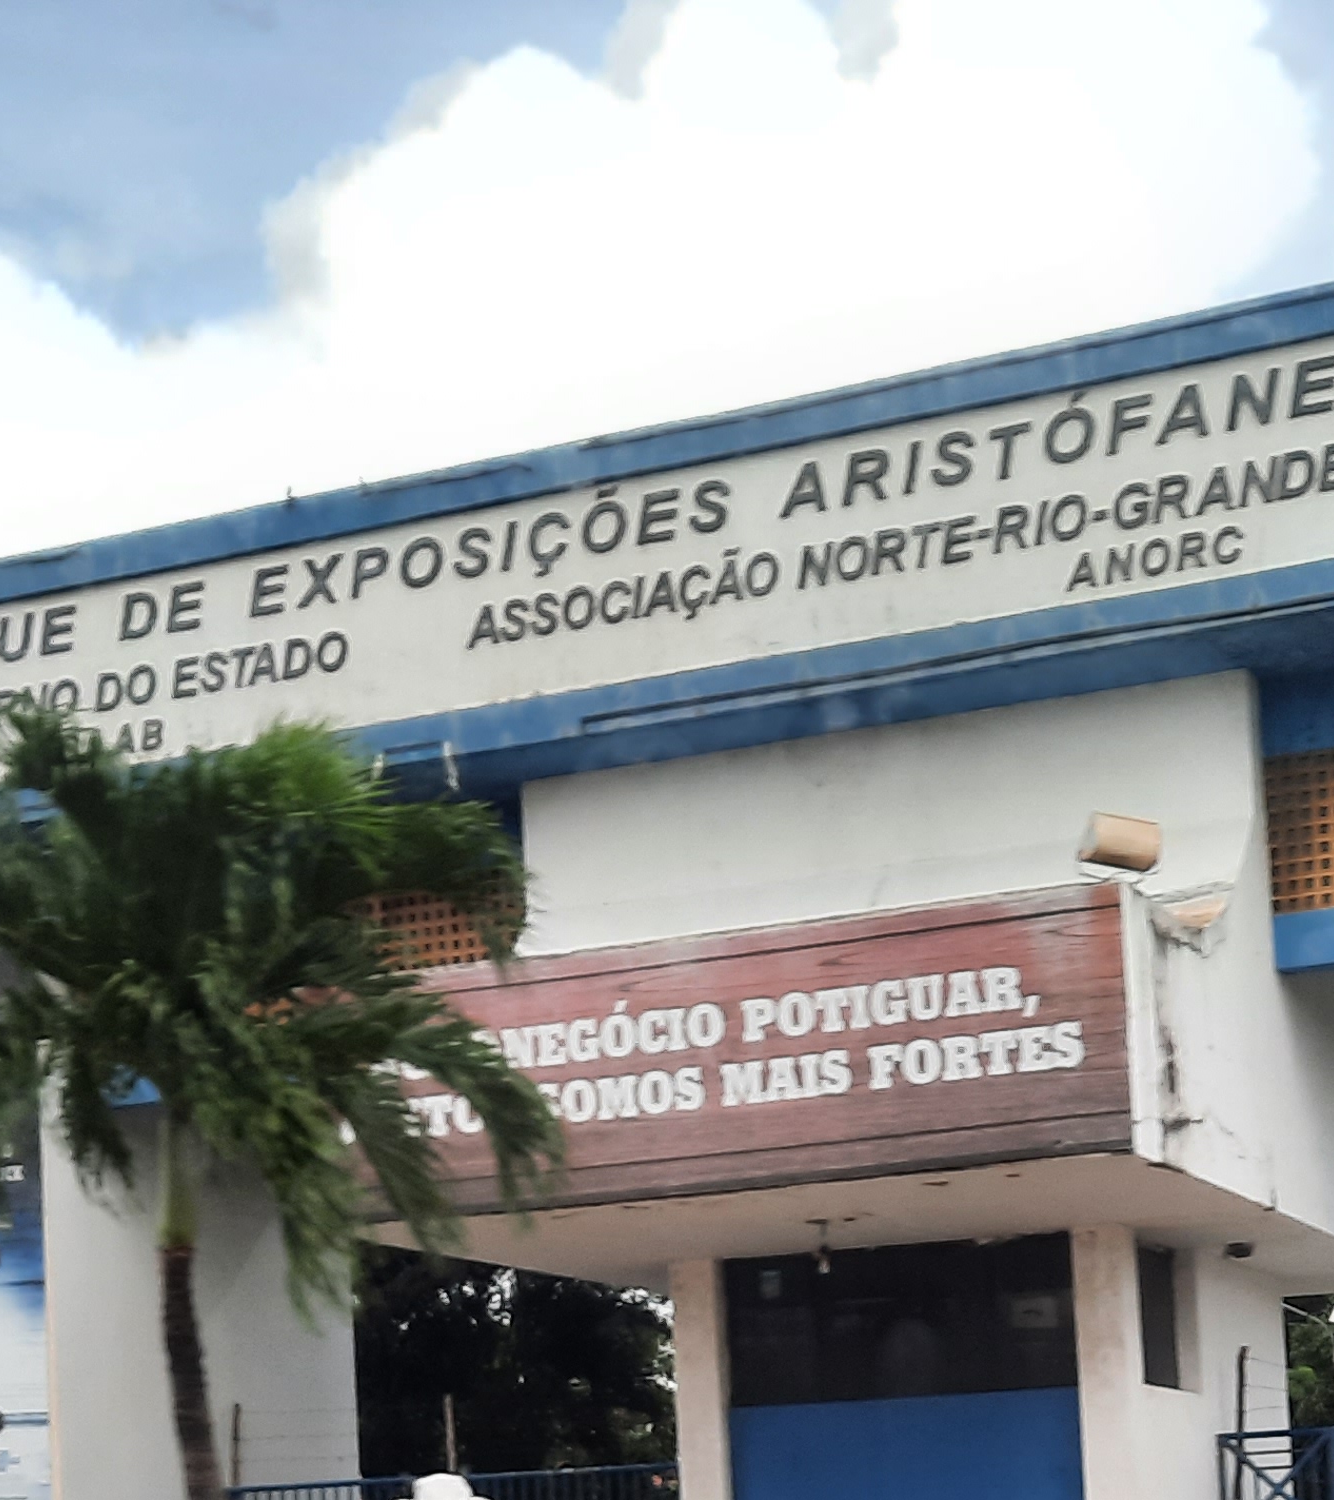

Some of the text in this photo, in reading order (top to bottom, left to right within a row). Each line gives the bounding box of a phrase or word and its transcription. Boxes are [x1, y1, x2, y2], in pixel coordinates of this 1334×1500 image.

[119, 580, 206, 642] DE
[248, 481, 731, 618] EXPOSIÇÕES
[467, 547, 780, 650] ASSOCIAÇÃO
[1066, 525, 1244, 592] ANORC
[95, 665, 158, 712] DO
[172, 631, 349, 699] ESTADO
[741, 966, 1042, 1043] POTIGUAR,
[720, 1049, 854, 1107] MAIS
[866, 1020, 1086, 1090] FORTES
